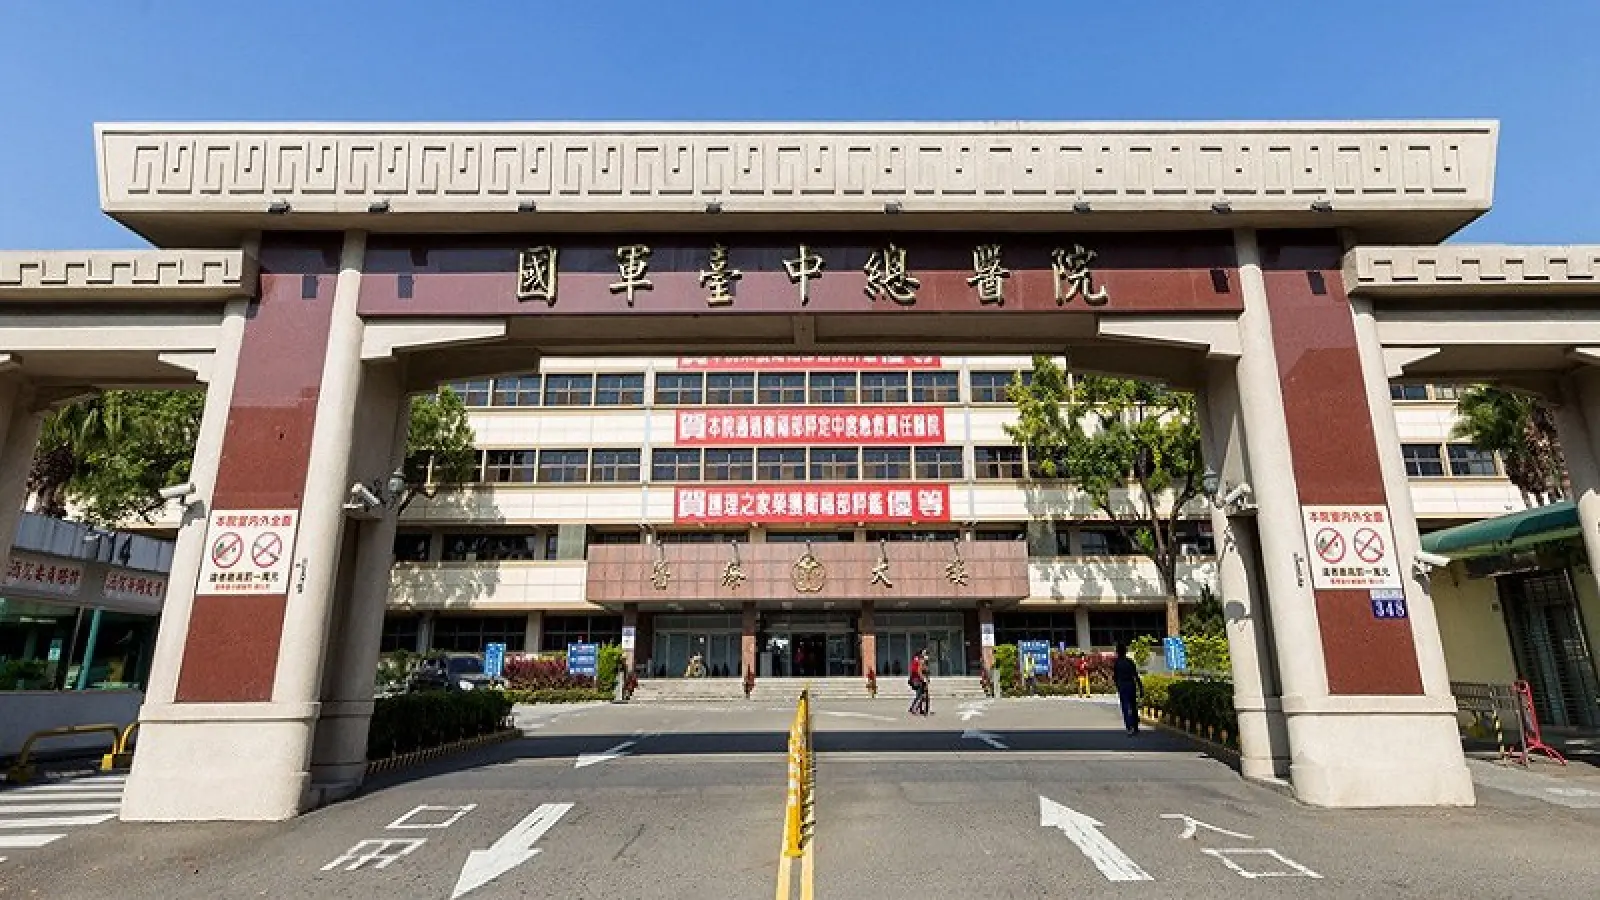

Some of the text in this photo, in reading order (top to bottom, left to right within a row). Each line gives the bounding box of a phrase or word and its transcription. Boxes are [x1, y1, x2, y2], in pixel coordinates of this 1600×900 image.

[516, 244, 1108, 306] 國軍臺中總醫院
